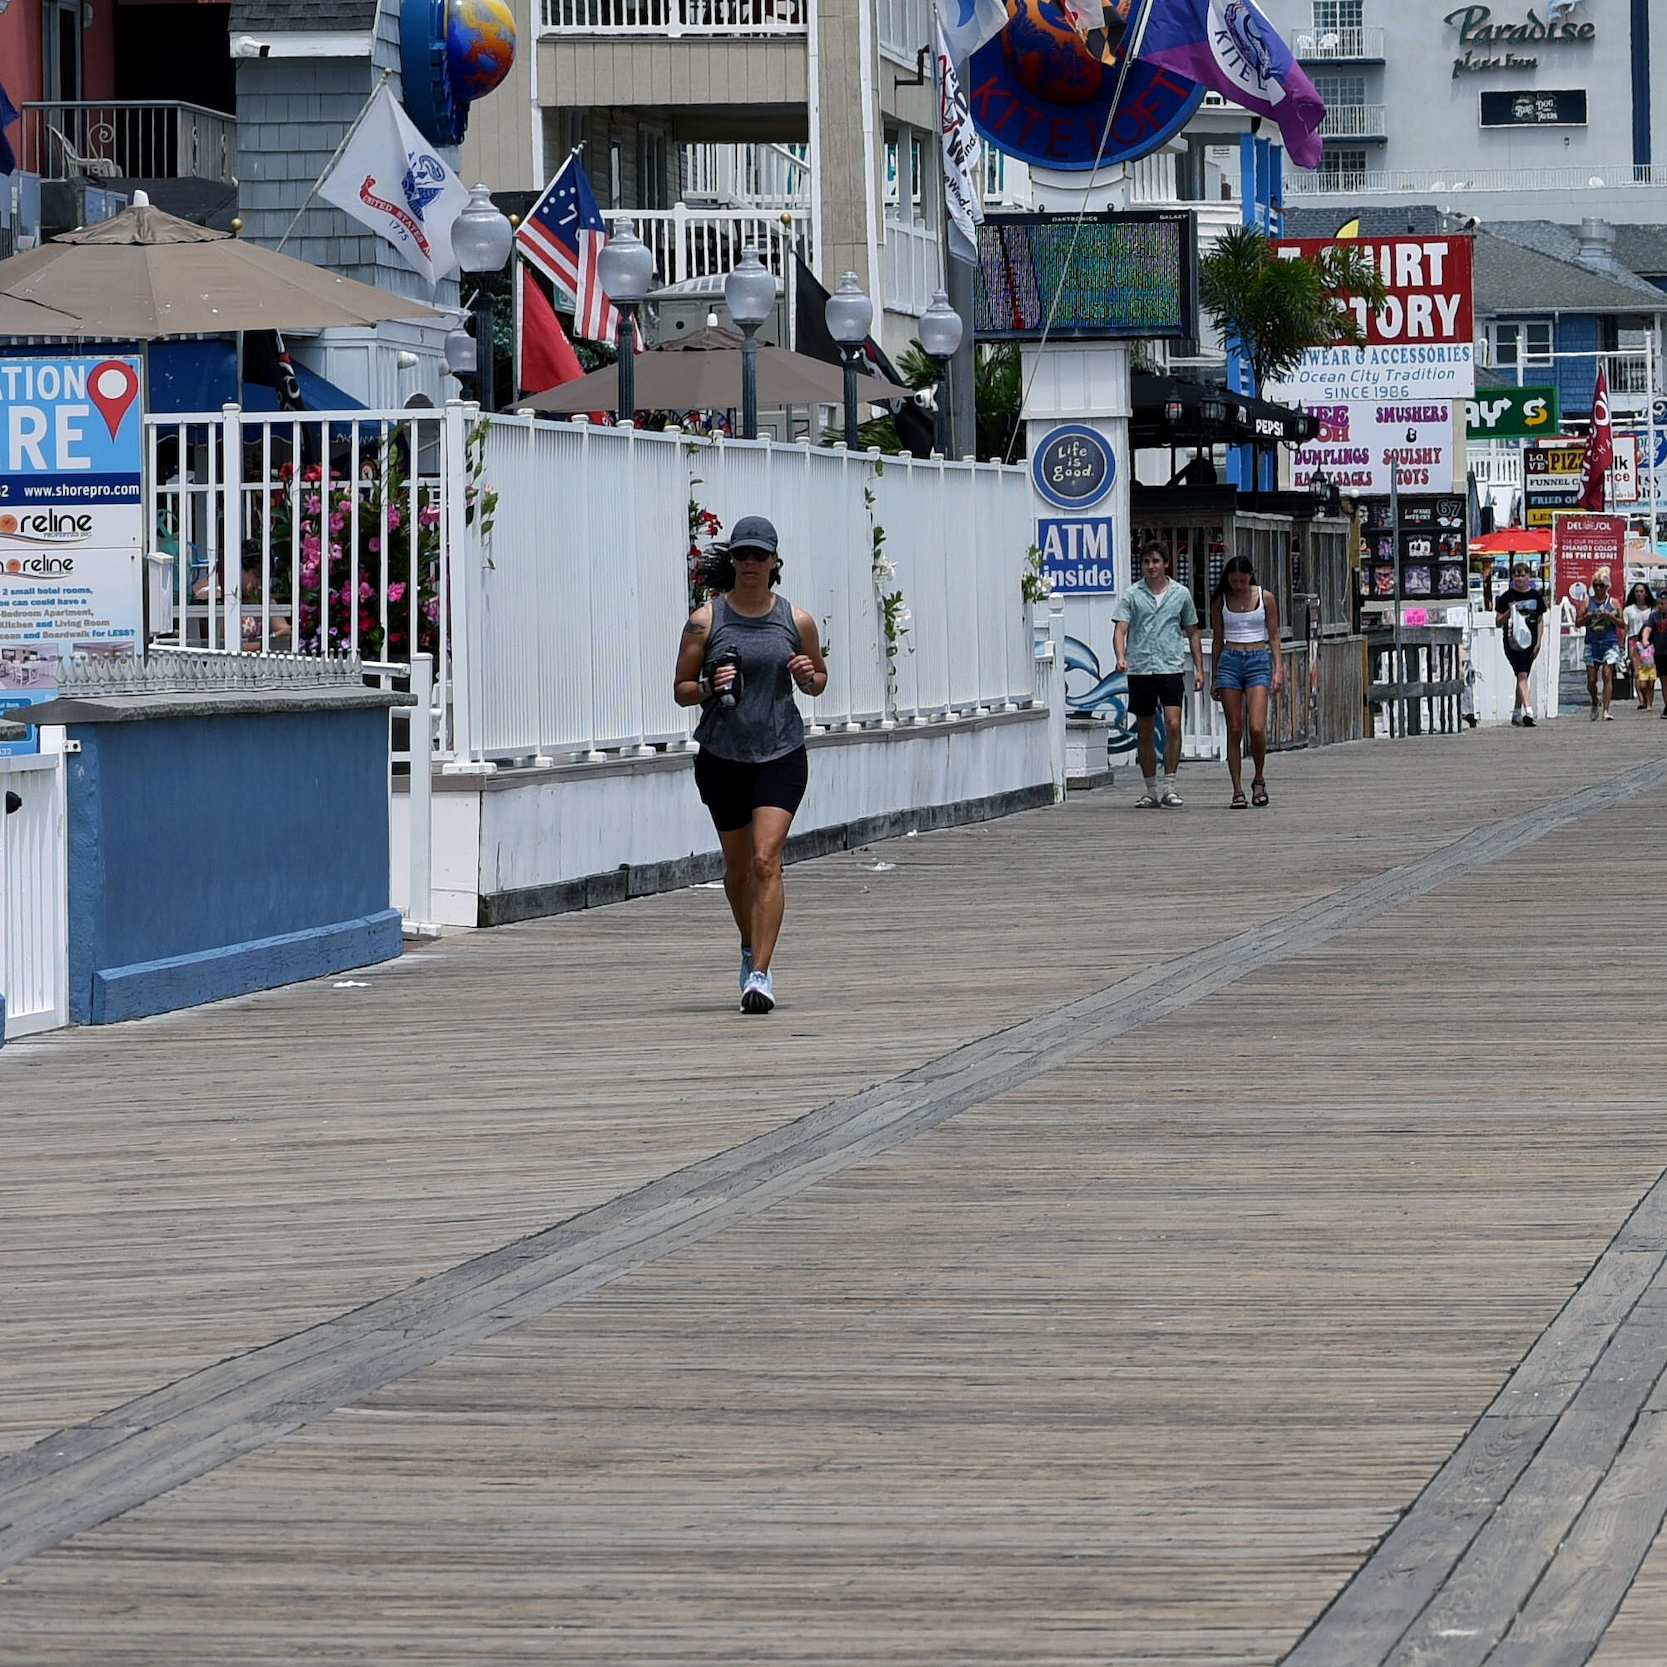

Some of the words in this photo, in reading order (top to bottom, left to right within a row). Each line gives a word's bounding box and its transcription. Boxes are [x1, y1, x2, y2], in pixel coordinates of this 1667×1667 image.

[1443, 5, 1596, 45] Paradise
[1213, 28, 1252, 82] KITE
[970, 75, 1068, 159] KITE
[1092, 67, 1190, 159] LOFT
[361, 191, 393, 214] UNITED
[395, 209, 425, 245] STATES
[388, 219, 409, 242] 1775
[1370, 344, 1470, 366] ACCESSORIES
[1299, 370, 1346, 383] Ocean
[1350, 369, 1380, 385] City
[1385, 368, 1456, 382] Tradition
[1324, 387, 1369, 399] SINCE
[1374, 384, 1409, 398] 1986
[1375, 405, 1449, 424] SMUSHERS
[1255, 418, 1284, 436] PEPSI
[1406, 427, 1417, 443] &
[1057, 441, 1088, 459] Life
[1294, 447, 1370, 466] DUMPLINGS
[1382, 447, 1443, 465] SQUISHY
[1067, 456, 1082, 467] is
[1550, 452, 1584, 471] PIZZ
[1052, 464, 1095, 482] good.
[1336, 470, 1373, 487] SACKS
[1396, 468, 1430, 485] TOYS
[1529, 477, 1570, 486] FUNNEL
[24, 483, 140, 498] www.shorepro.com
[1436, 500, 1462, 517] 67
[1530, 495, 1562, 505] FRIED
[1566, 521, 1583, 531] DEL
[1594, 521, 1612, 531] SOL
[1043, 523, 1109, 561] ATM
[1561, 552, 1573, 560] IN
[1575, 552, 1592, 560] THE
[1594, 552, 1618, 560] SUN!
[1043, 564, 1112, 588] inside
[11, 587, 35, 595] small
[37, 586, 61, 594] hotel
[31, 598, 56, 606] could
[44, 608, 94, 617] Apartment,
[36, 620, 53, 628] and
[55, 619, 82, 628] Living
[84, 619, 110, 627] Room
[42, 630, 90, 639] Boardwalk
[92, 629, 105, 637] for
[107, 629, 135, 637] LESS?
